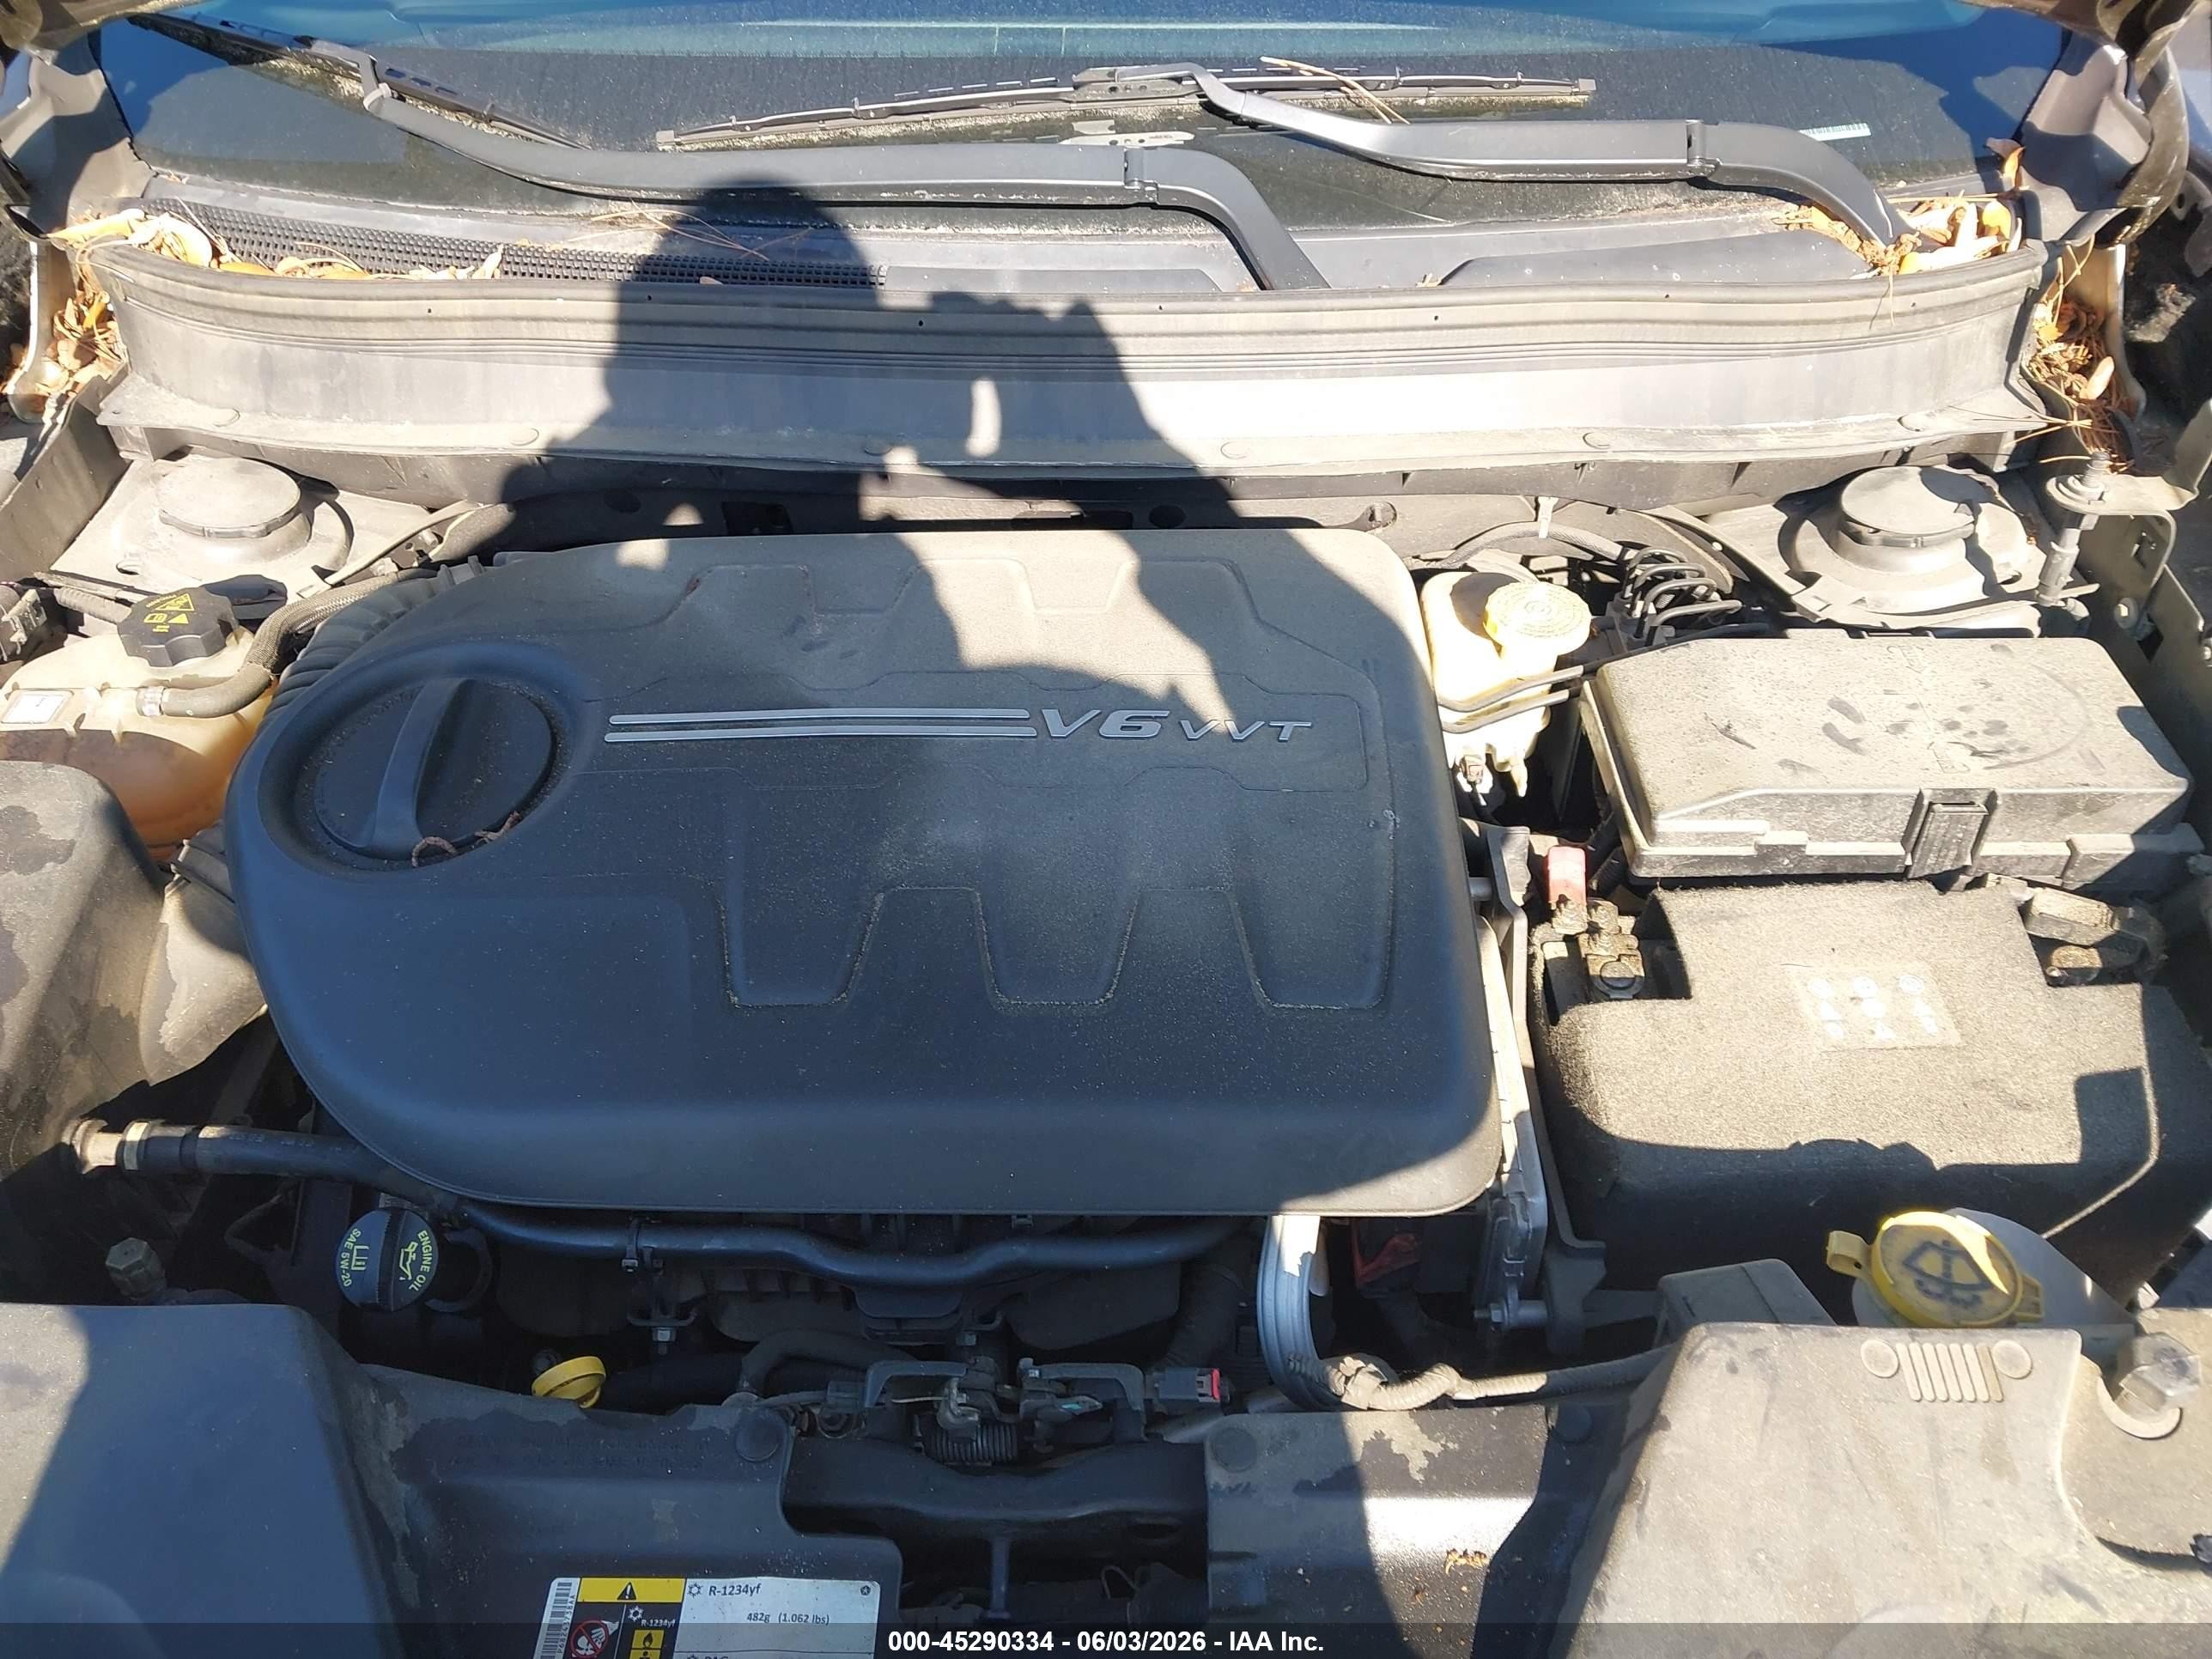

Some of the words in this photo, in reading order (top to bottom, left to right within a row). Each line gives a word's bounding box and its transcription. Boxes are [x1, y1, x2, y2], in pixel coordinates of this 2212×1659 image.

[1041, 708, 1170, 738] V6
[1179, 719, 1313, 742] VVT
[343, 1228, 362, 1250] SAE
[417, 1230, 433, 1273] ENGINE
[340, 1252, 352, 1287] 5W-20
[408, 1274, 426, 1291] OIL
[708, 1583, 762, 1596] R-1234yf
[641, 1619, 676, 1628] R-1234yf
[746, 1612, 770, 1624] 482g
[778, 1612, 809, 1625] (1.062
[811, 1613, 830, 1626] lbs)
